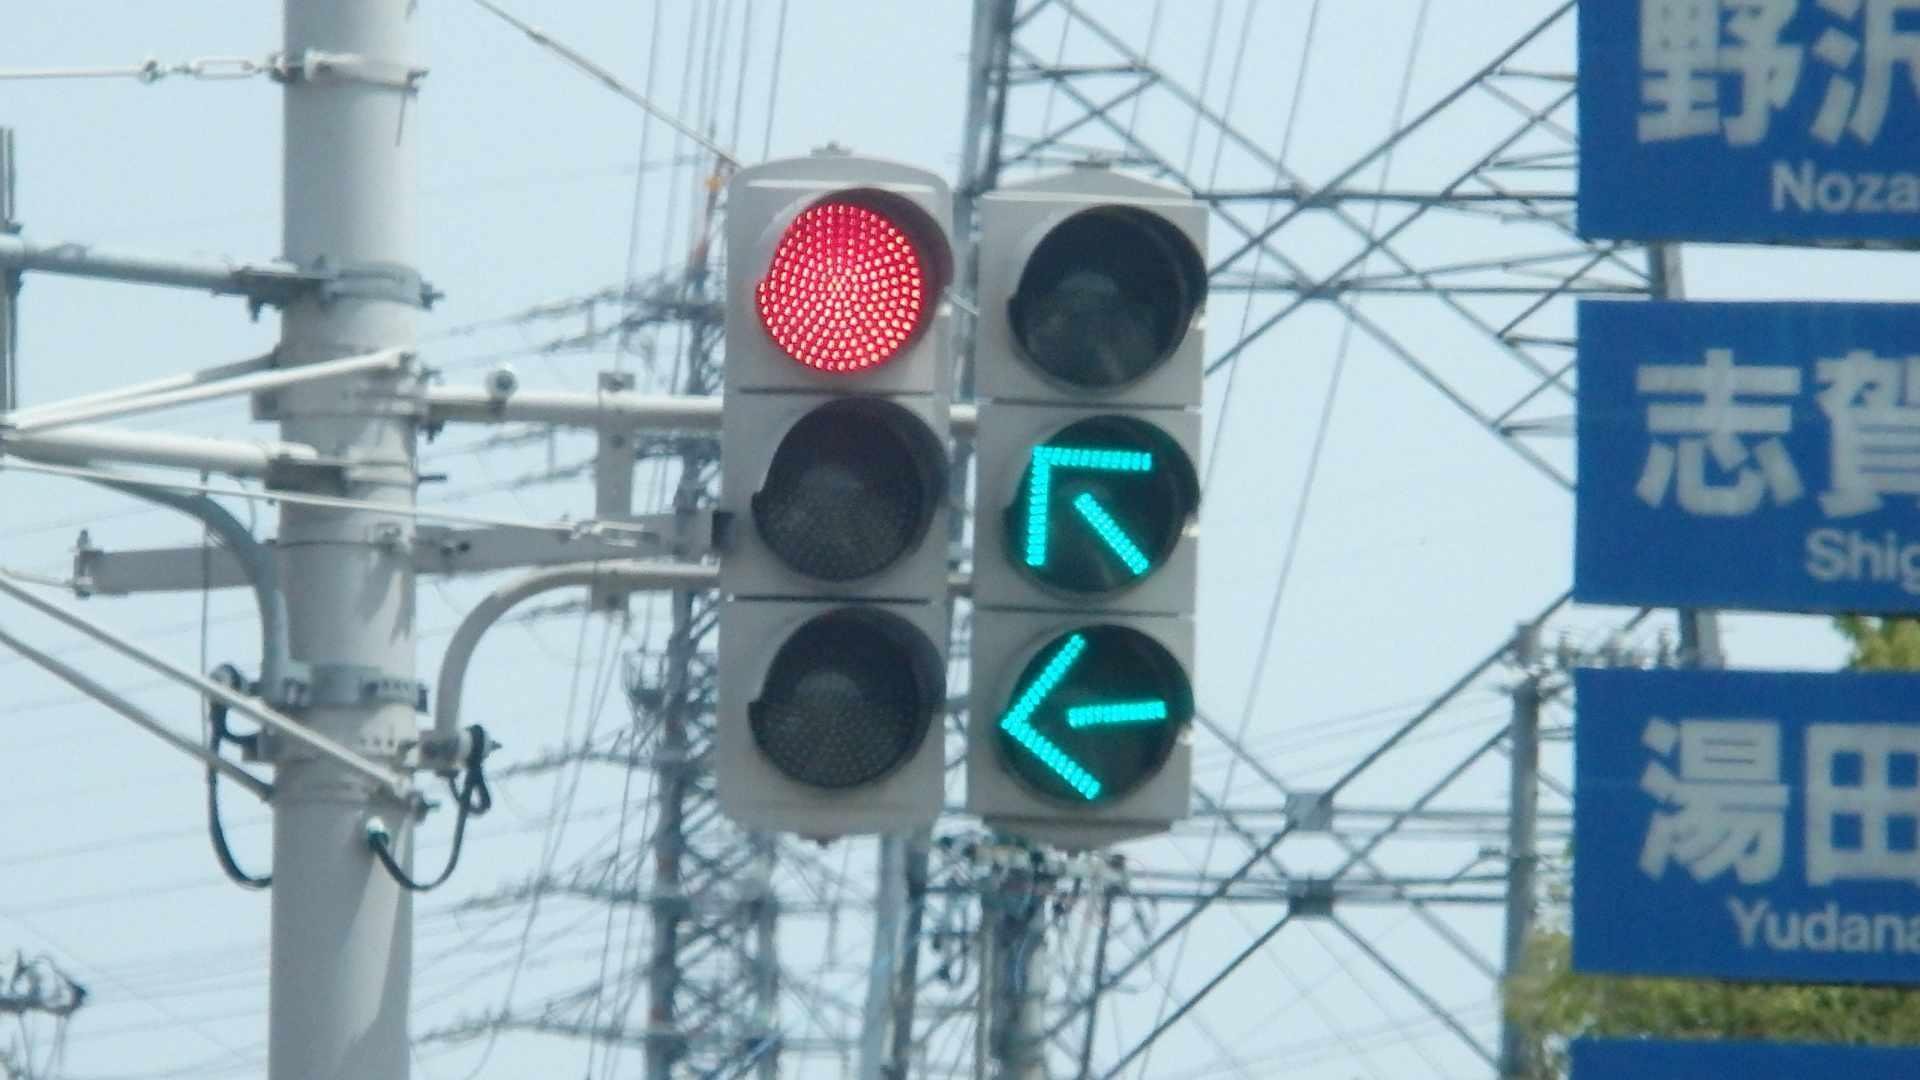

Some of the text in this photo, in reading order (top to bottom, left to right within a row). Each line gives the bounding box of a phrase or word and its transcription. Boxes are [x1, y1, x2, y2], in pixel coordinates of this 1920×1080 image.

[1771, 159, 1920, 213] Noza
[1636, 348, 1920, 517] 志賀
[1638, 717, 1920, 887] 湯田
